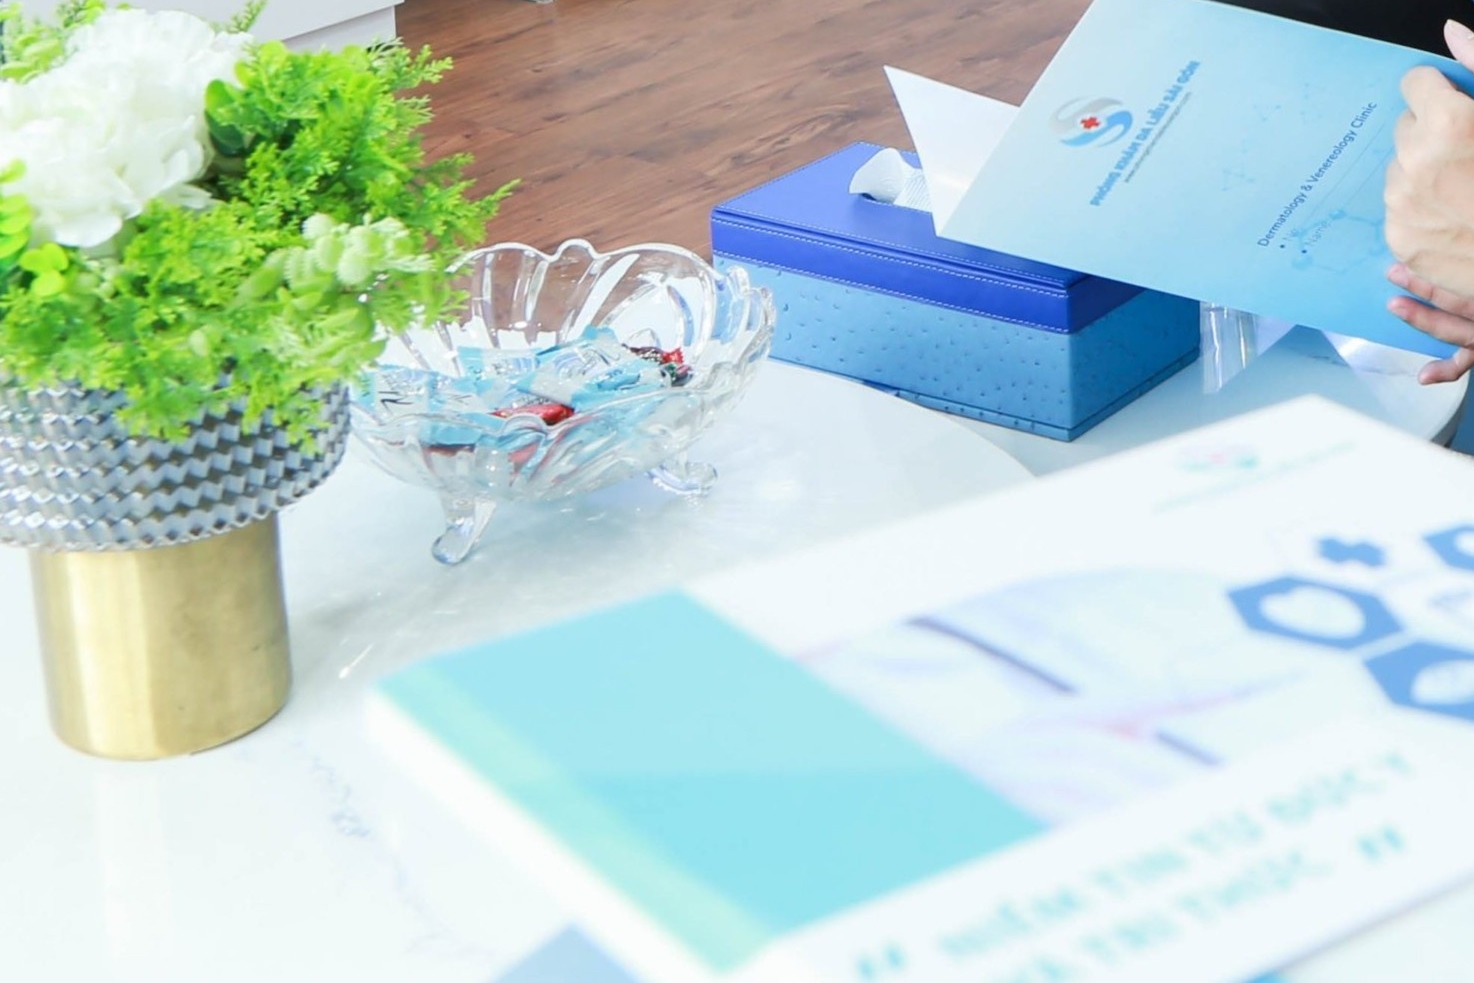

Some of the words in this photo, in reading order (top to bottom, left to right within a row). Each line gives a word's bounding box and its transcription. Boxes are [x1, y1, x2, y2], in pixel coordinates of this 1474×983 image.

[1257, 192, 1308, 247] Dermatology
[1306, 129, 1358, 183] Venereology
[1350, 102, 1378, 129] Clinic
